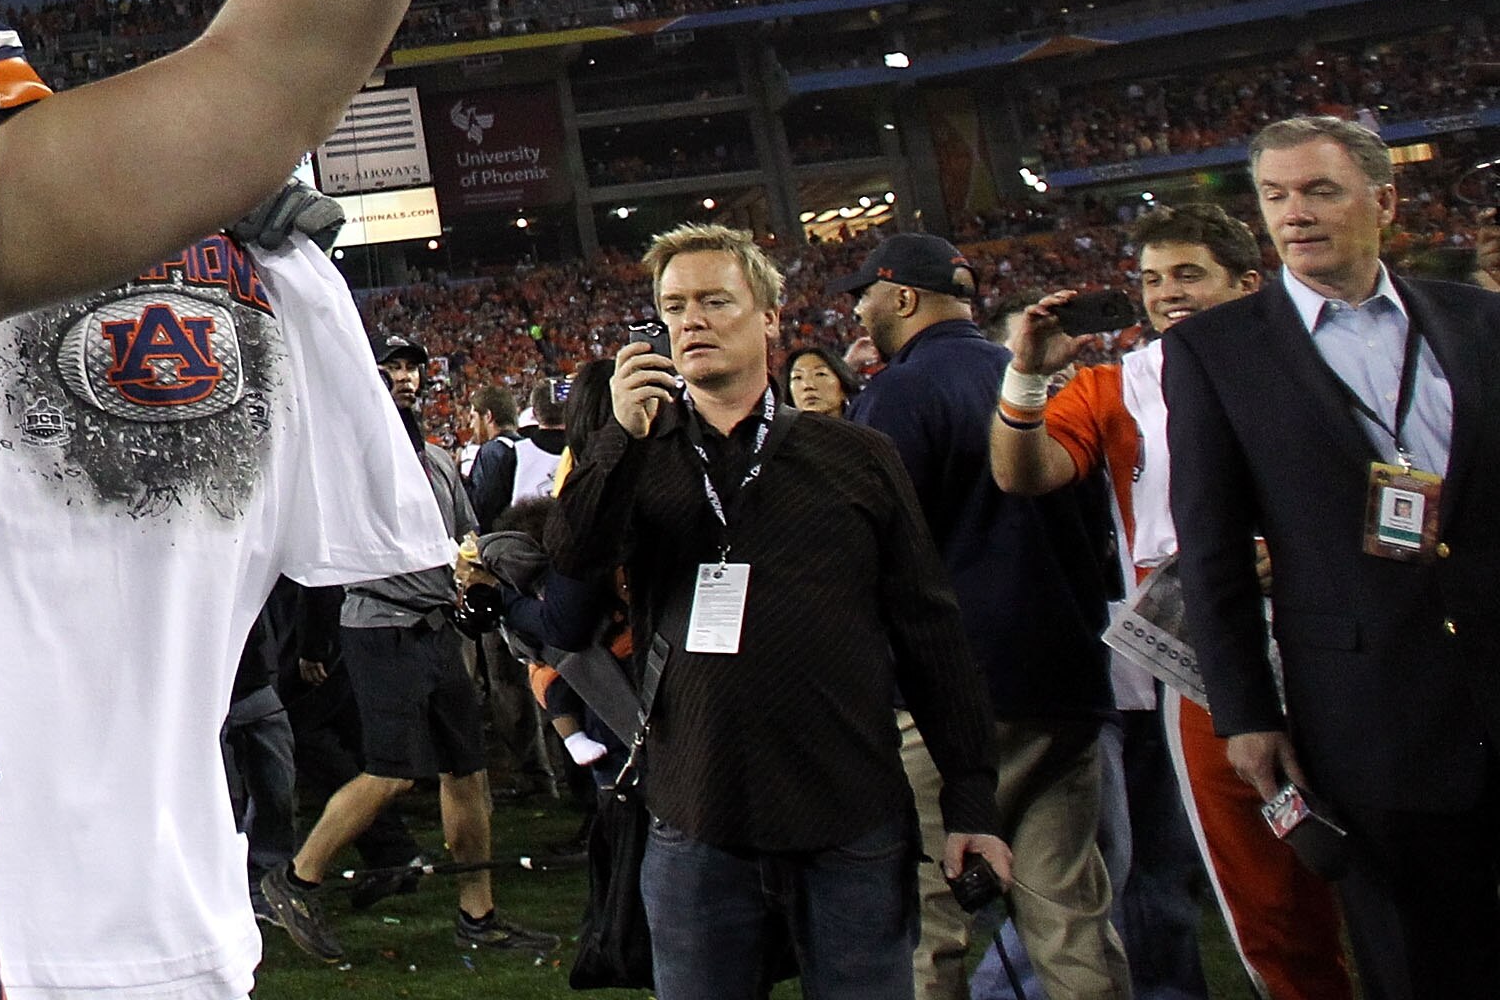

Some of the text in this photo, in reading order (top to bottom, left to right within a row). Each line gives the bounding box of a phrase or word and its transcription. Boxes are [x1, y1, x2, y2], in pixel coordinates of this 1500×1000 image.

[456, 145, 540, 167] University
[329, 164, 422, 183] US AIRWAYS
[460, 165, 549, 188] of Phoenix
